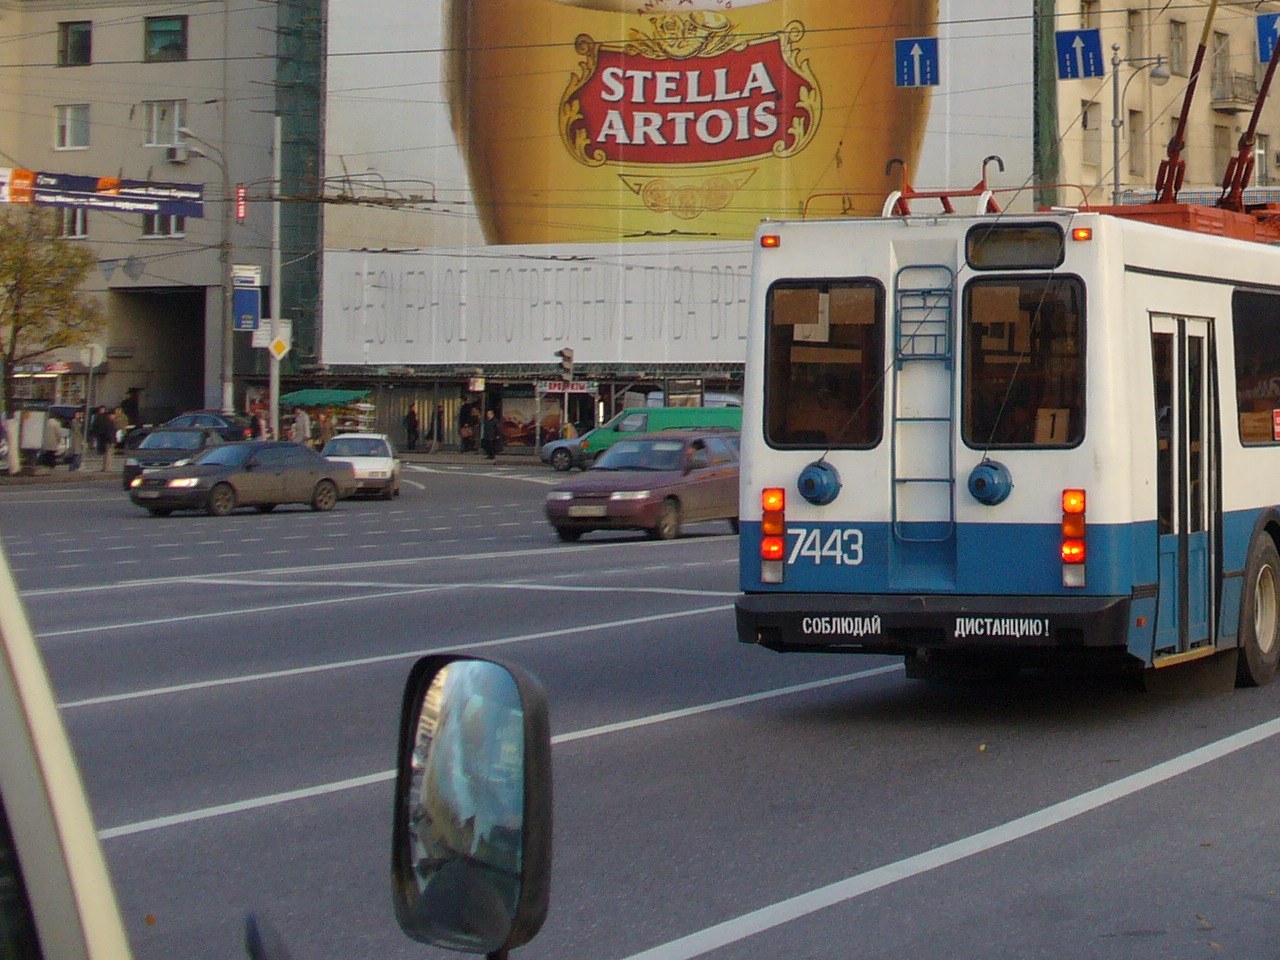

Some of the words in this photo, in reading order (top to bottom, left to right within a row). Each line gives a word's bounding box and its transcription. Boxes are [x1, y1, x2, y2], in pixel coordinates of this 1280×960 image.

[600, 62, 777, 105] STELLA
[596, 101, 779, 146] ARTOIS
[787, 528, 864, 566] 7443
[802, 613, 882, 636] СОБЛЮДАЙ
[954, 616, 1050, 639] ДИСТАНЦИЮ!
